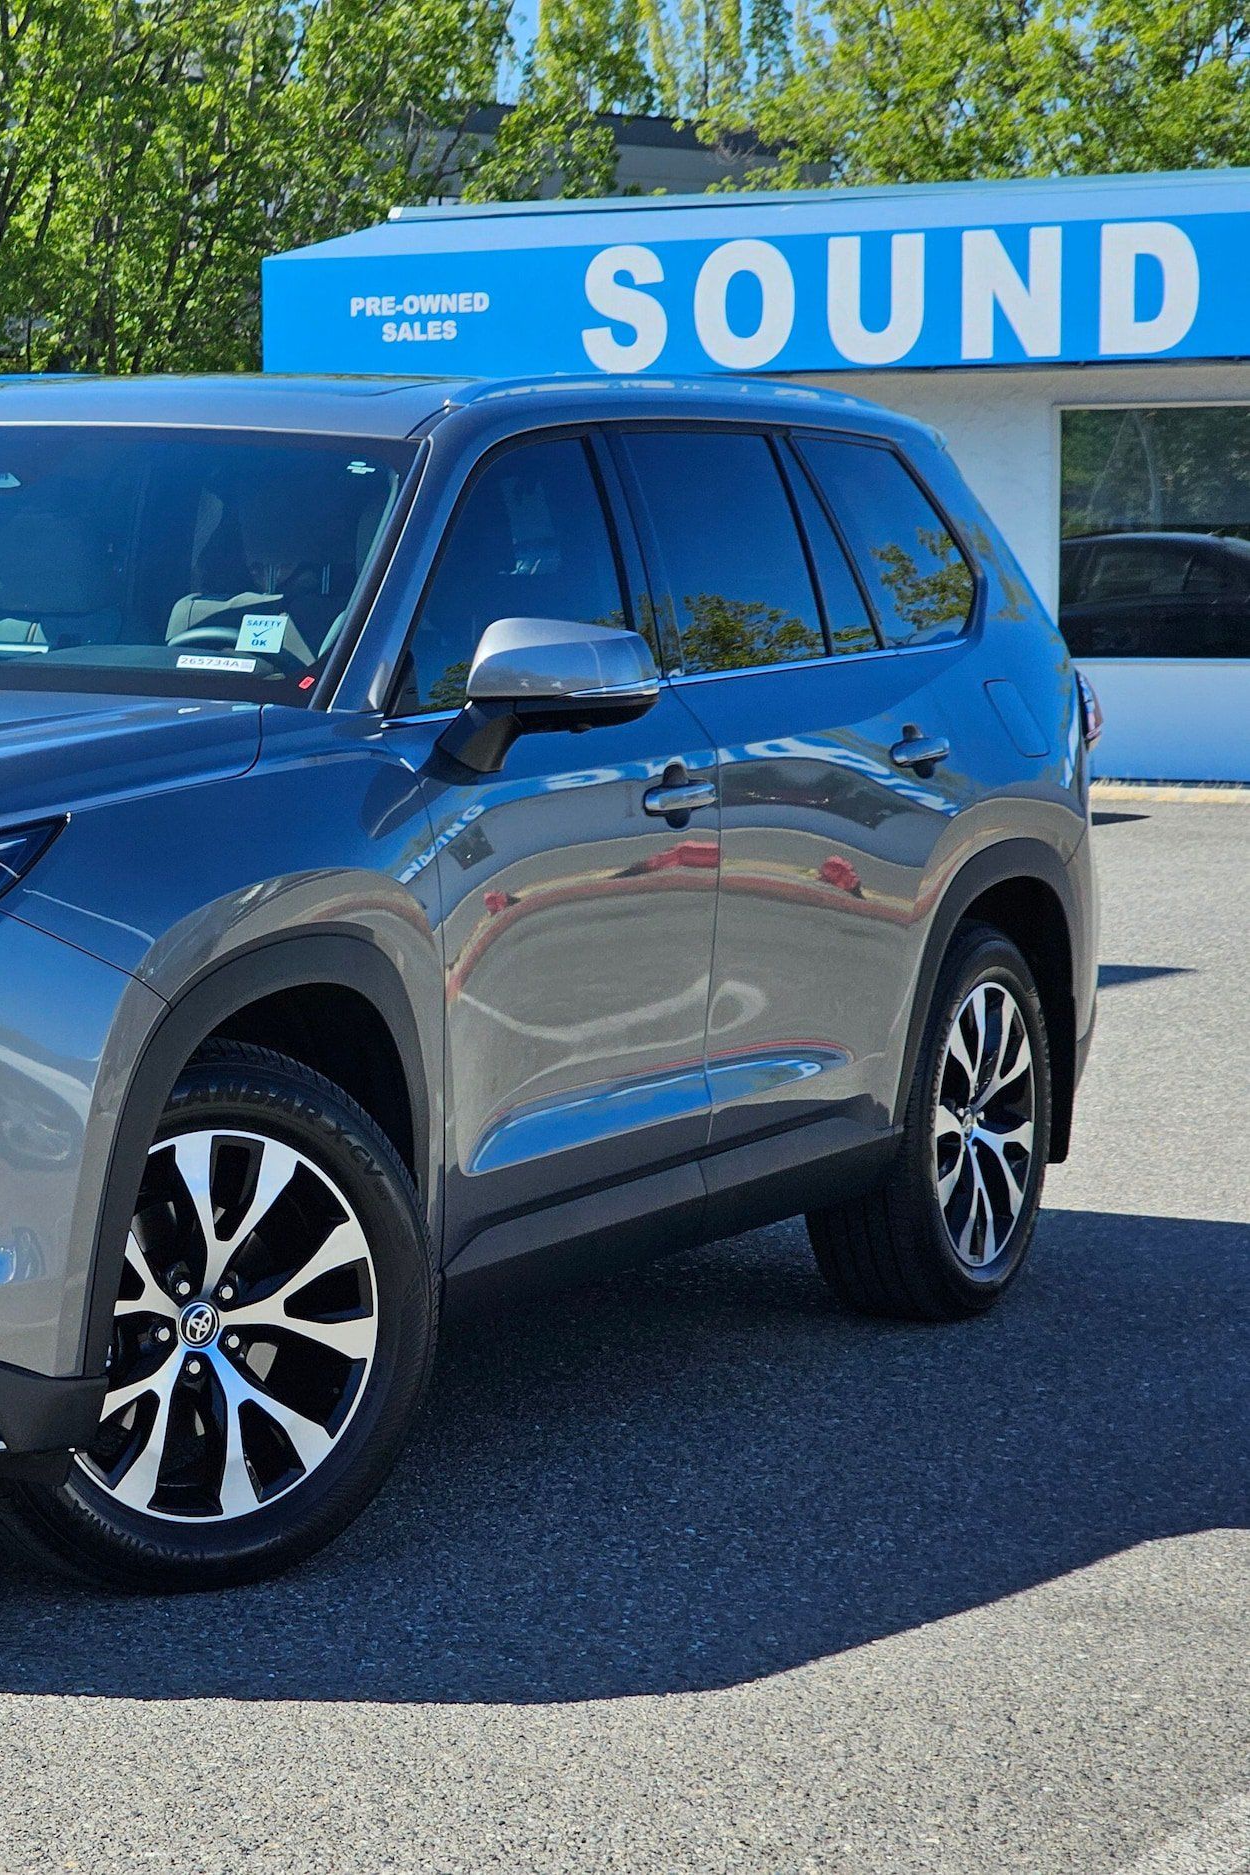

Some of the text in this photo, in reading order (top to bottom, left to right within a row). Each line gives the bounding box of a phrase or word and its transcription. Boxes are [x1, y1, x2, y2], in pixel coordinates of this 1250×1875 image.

[350, 291, 490, 318] PRE-OWNED
[581, 221, 1200, 374] SOUND
[381, 320, 458, 343] SALES
[246, 618, 283, 628] SAFETY
[251, 638, 268, 648] OK
